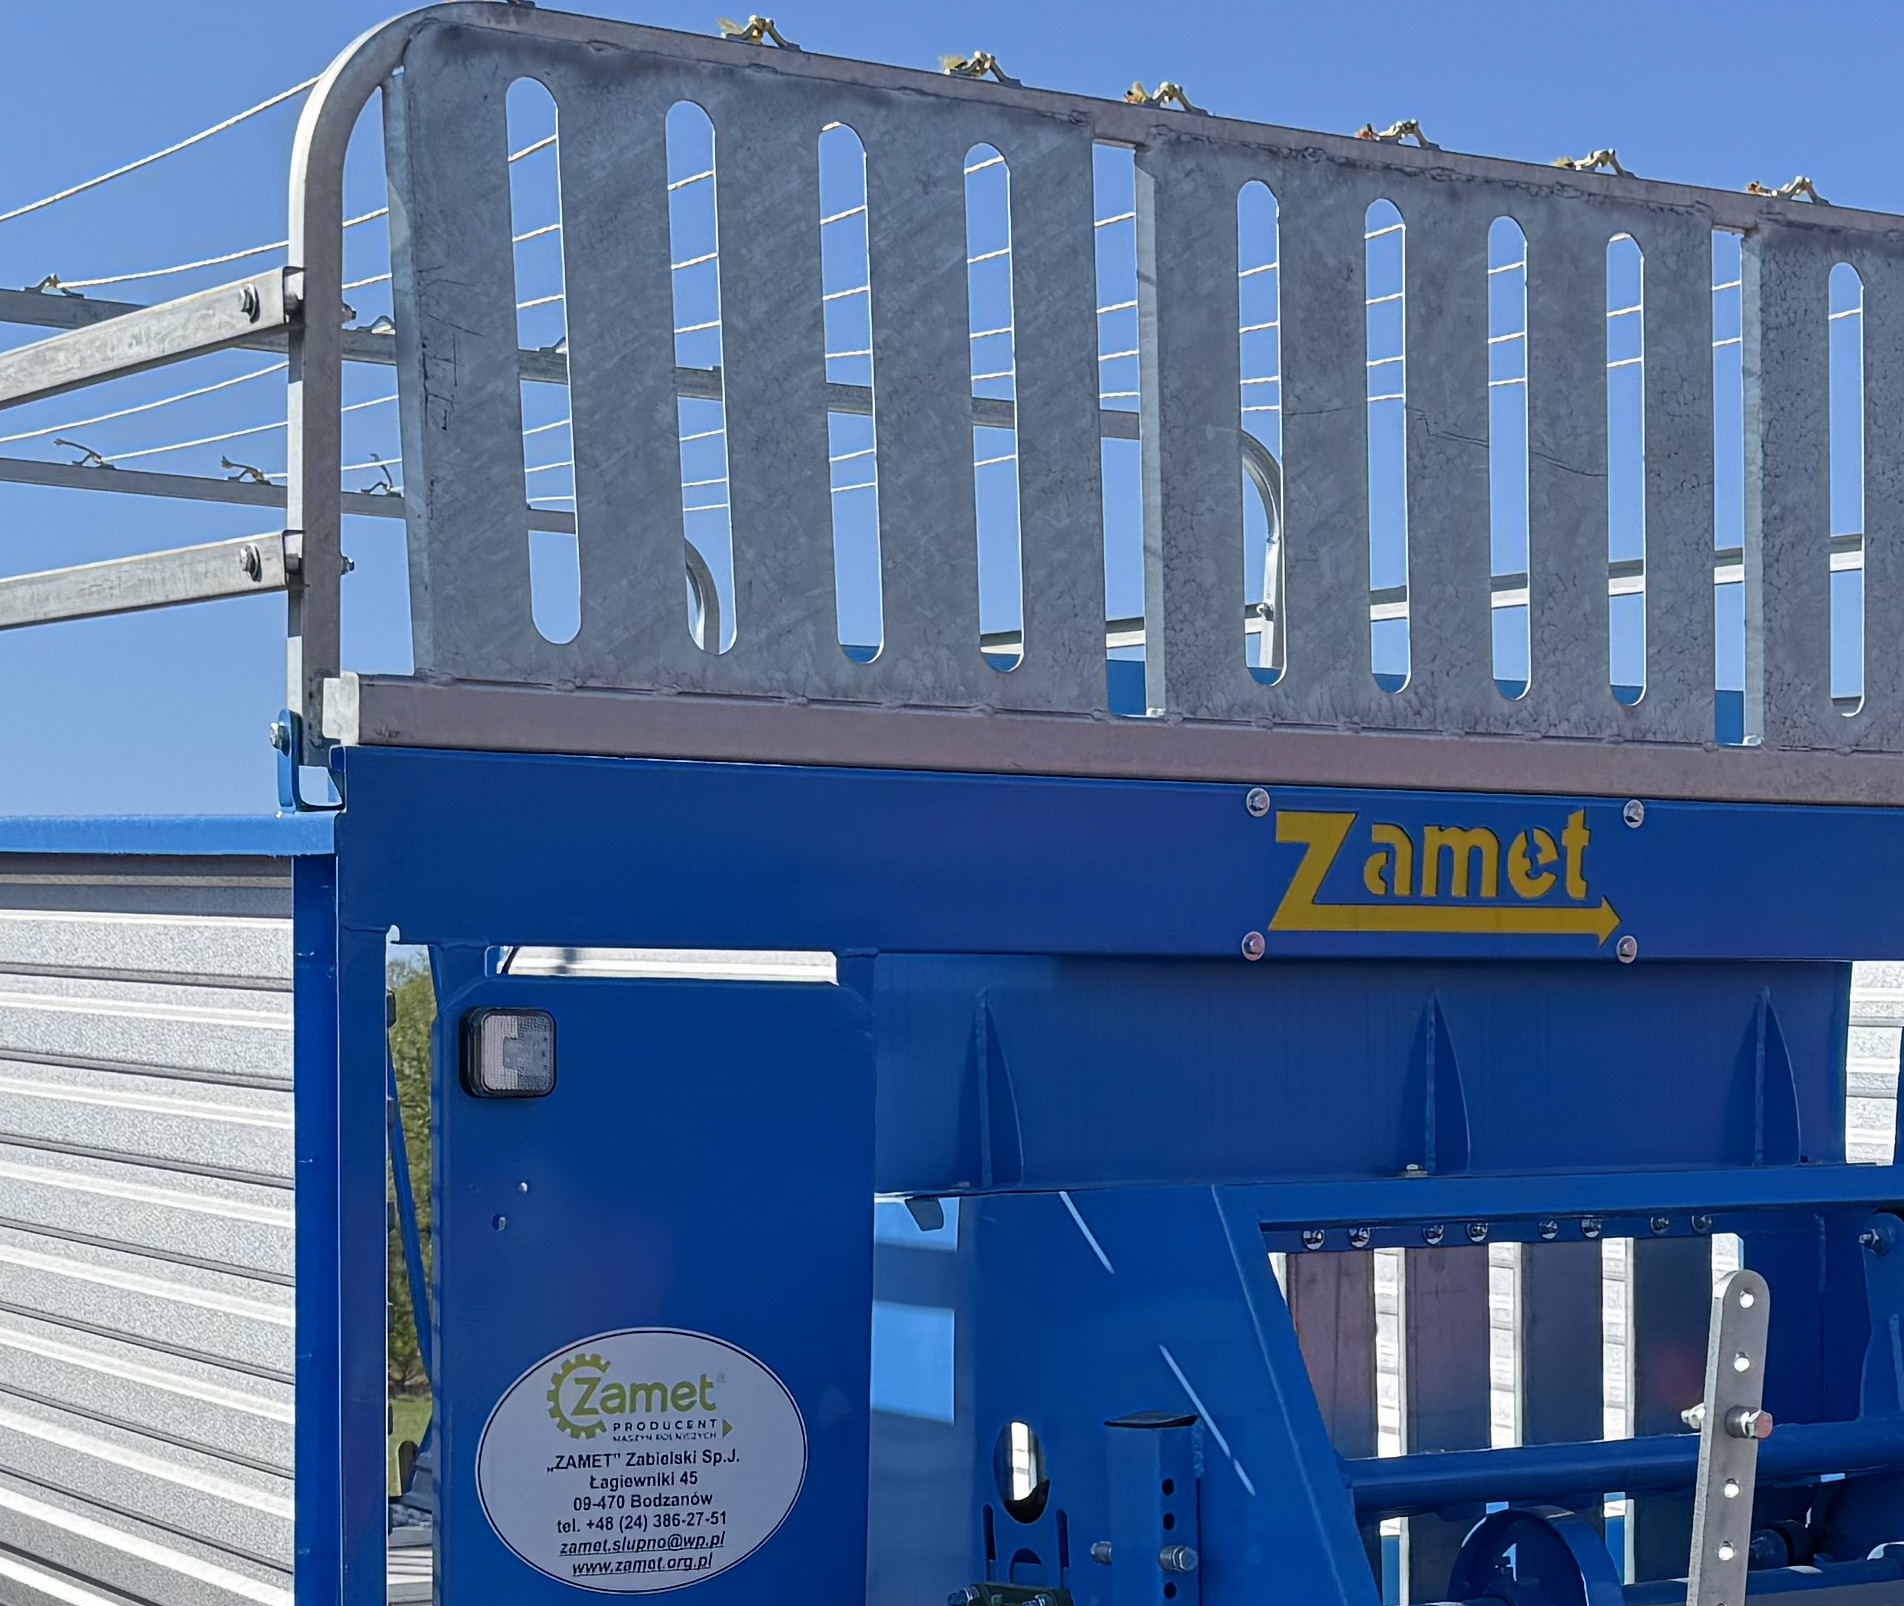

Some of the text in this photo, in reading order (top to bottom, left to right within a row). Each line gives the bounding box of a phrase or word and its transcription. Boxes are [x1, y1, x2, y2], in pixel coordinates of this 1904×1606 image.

[1269, 807, 1592, 932] Zamet
[571, 1373, 717, 1418] Zamet
[612, 1417, 718, 1432] PRODUCENT
[626, 1449, 697, 1468] Zabielski
[702, 1448, 741, 1467] Sp.J.
[589, 1470, 698, 1492] Łagiewniki 45
[573, 1491, 714, 1512] 09-470 Bodzanów
[557, 1510, 727, 1534] tel. +48 (24) 386-27-51
[559, 1530, 726, 1556] zamet.slupno@wp.pl
[572, 1552, 713, 1577] www.zamet.org.pl
